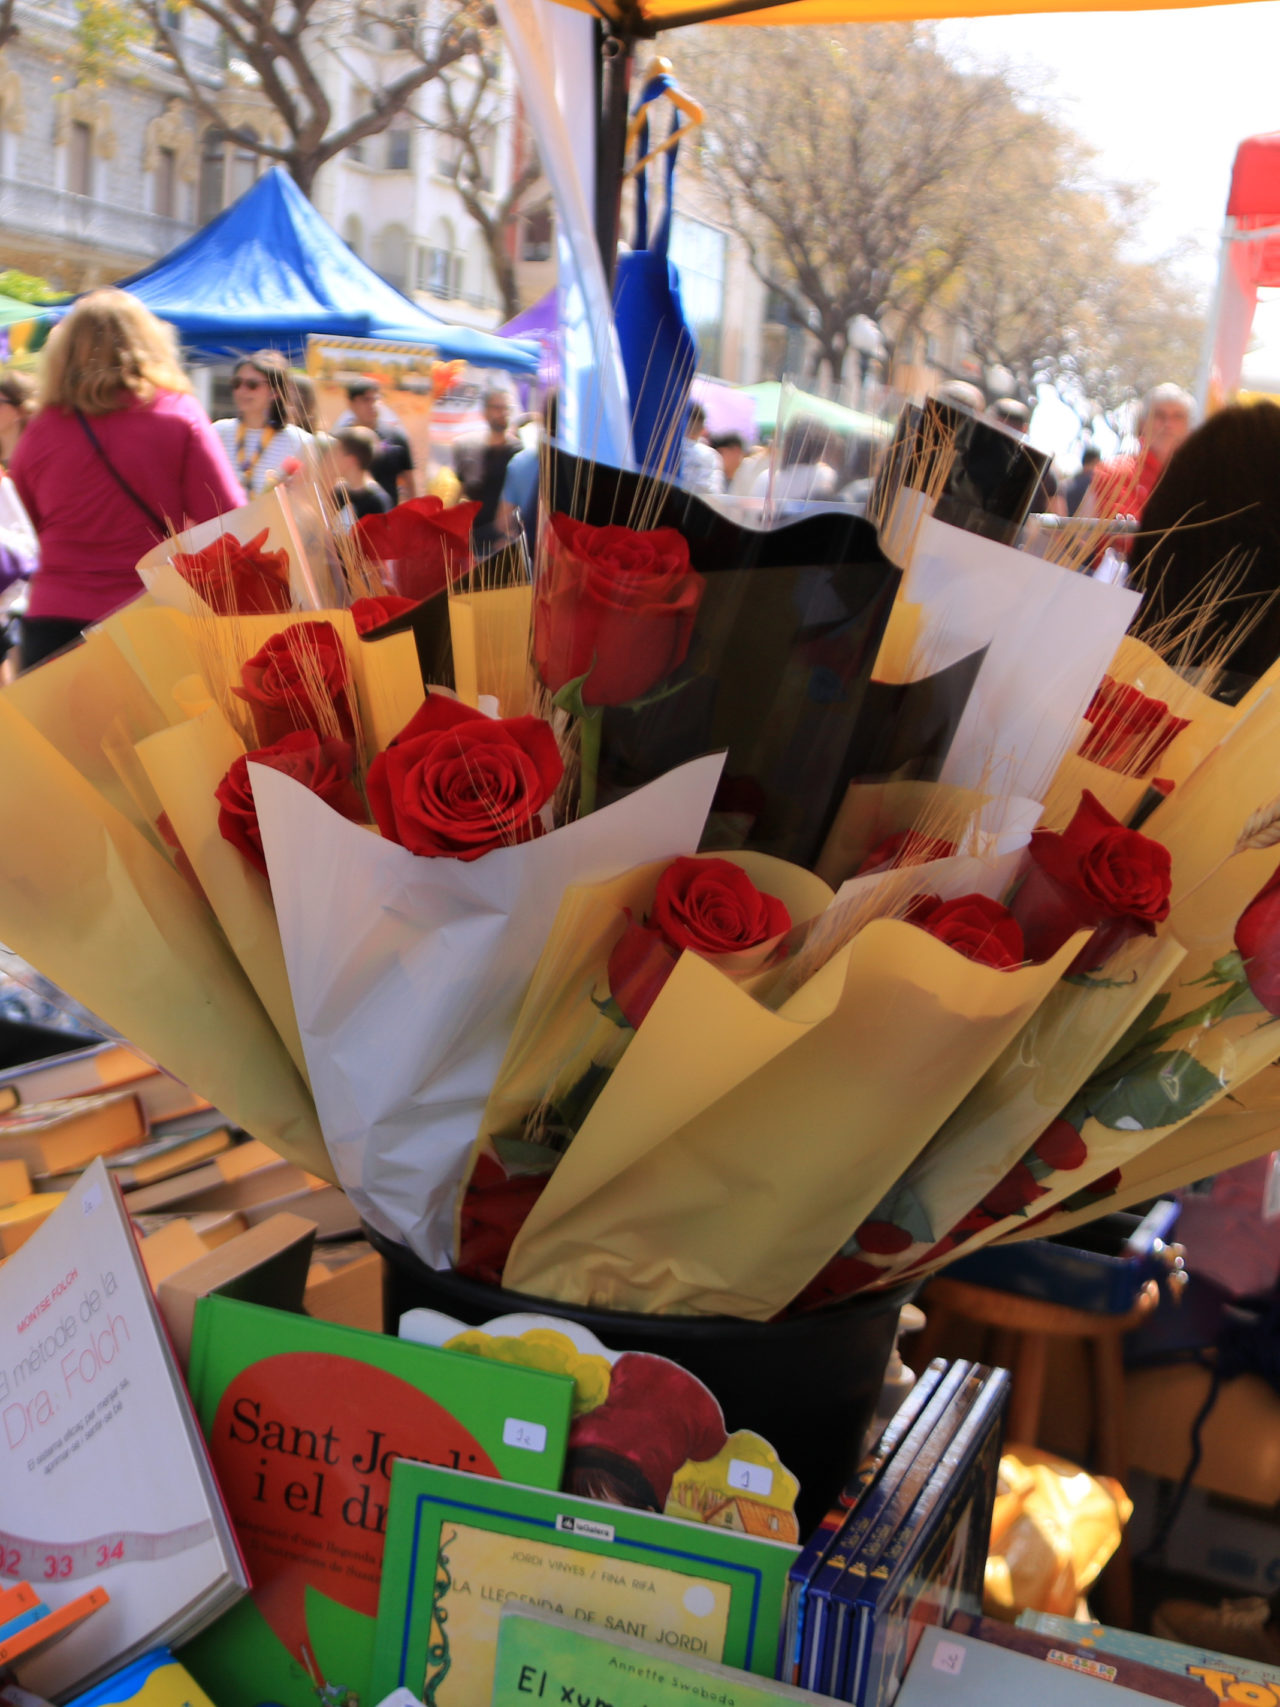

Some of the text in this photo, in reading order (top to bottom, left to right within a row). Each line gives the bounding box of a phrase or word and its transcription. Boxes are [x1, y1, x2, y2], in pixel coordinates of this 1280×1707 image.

[17, 1267, 79, 1335] MONTSE FOLCH
[79, 1284, 103, 1325] de
[102, 1268, 120, 1302] la
[1, 1308, 133, 1451] Dra. Folch
[229, 1397, 341, 1466] Sant
[253, 1457, 272, 1504] i
[284, 1472, 324, 1519] el
[43, 1555, 74, 1579] 33
[96, 1540, 125, 1567] 34
[510, 1550, 543, 1568] JORDI
[548, 1557, 587, 1578] VINYES
[600, 1571, 628, 1587] FINA
[452, 1577, 472, 1596] LA
[605, 1614, 649, 1639] SANT
[655, 1629, 710, 1656] JORDI
[517, 1664, 548, 1698] El
[608, 1656, 736, 1707] Annette Swoboda
